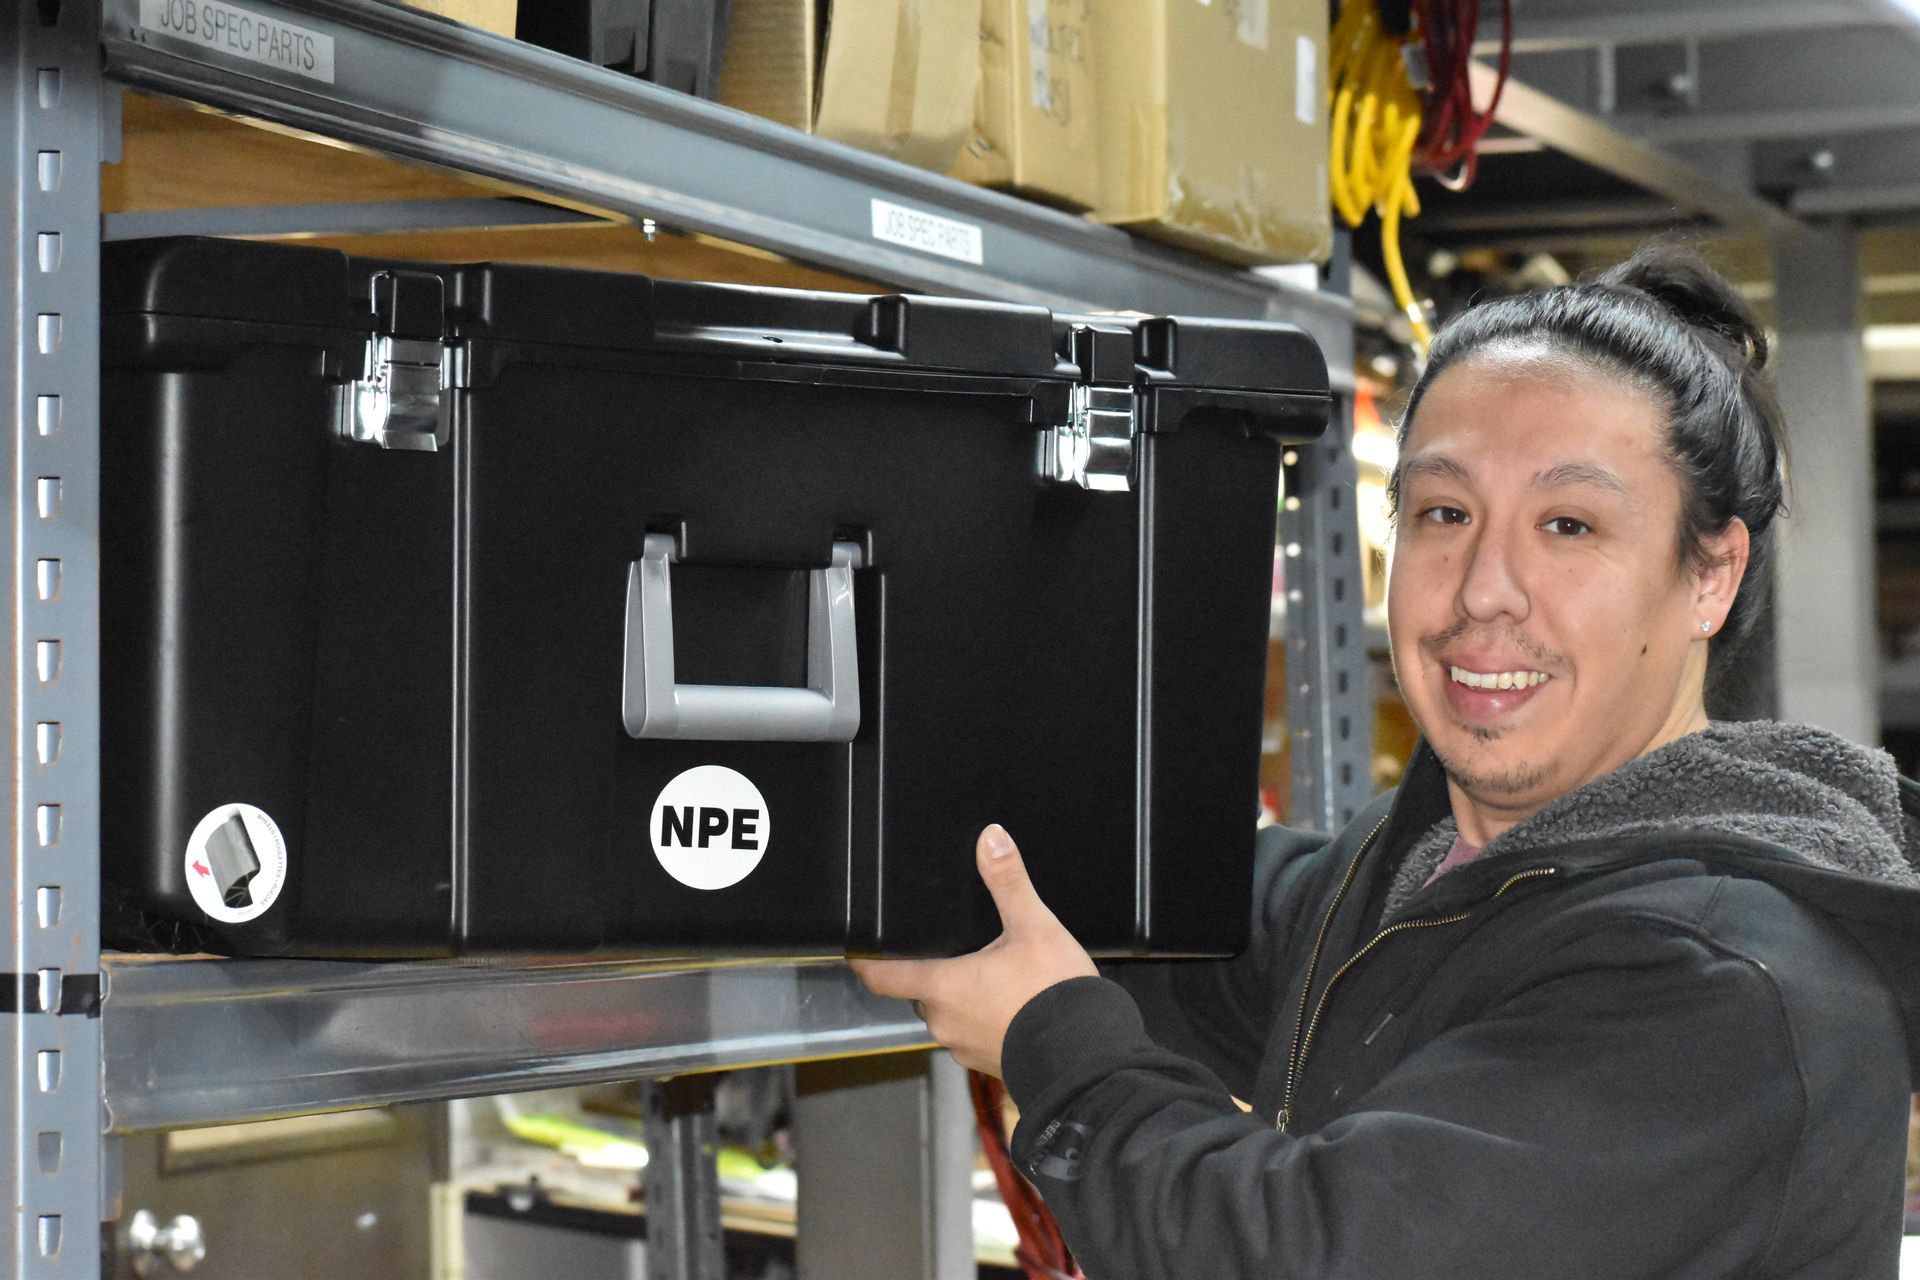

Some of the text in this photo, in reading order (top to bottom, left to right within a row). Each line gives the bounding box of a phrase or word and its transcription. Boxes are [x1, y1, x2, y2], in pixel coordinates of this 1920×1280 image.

[161, 0, 315, 70] JOB SPEC PARTS
[886, 210, 972, 256] JOB SPEC PARTS
[661, 805, 759, 850] NPE
